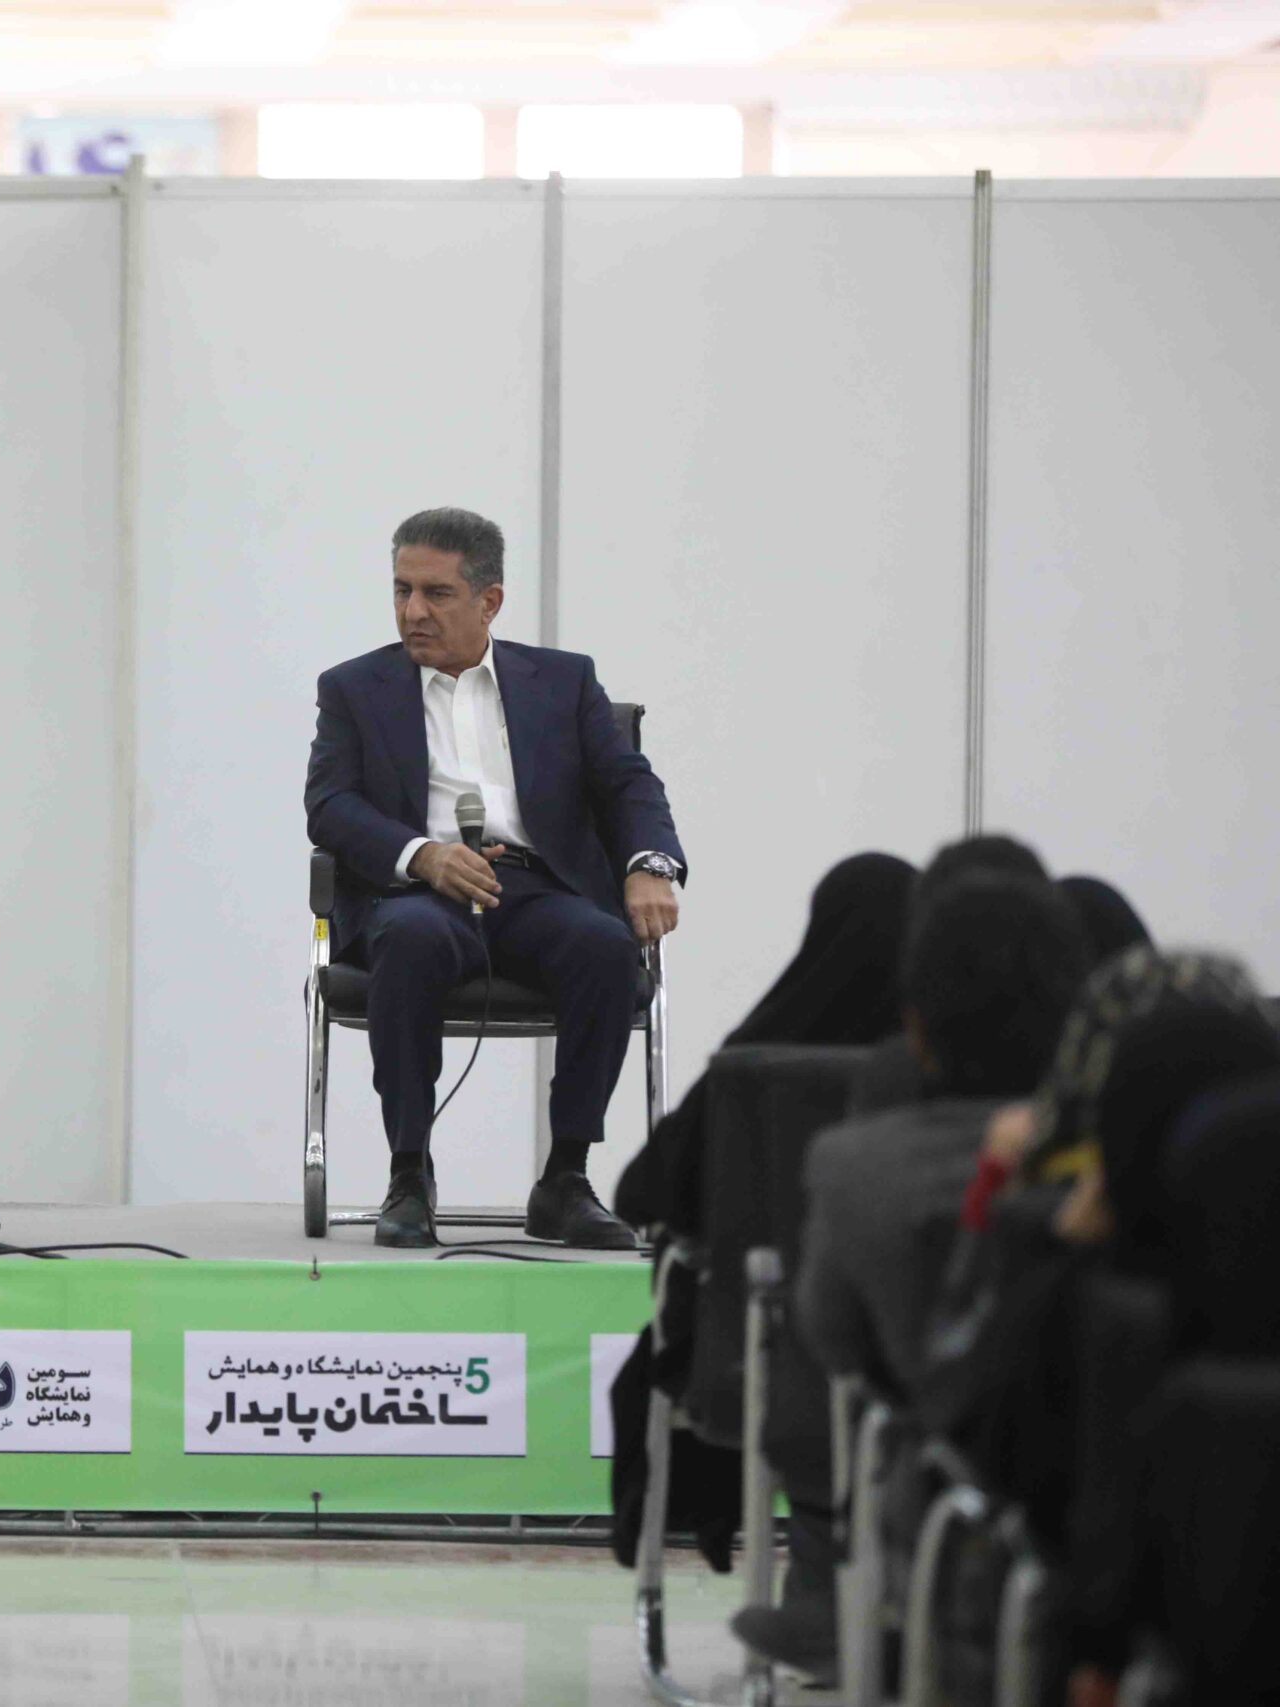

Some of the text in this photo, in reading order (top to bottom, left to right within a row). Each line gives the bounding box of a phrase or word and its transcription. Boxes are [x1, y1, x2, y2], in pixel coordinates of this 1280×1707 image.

[26, 1366, 92, 1384] سومین
[296, 1355, 384, 1380] نمایشگاه
[386, 1362, 463, 1388] پنجمین
[464, 1357, 491, 1395] 5
[25, 1385, 91, 1406] نمایشگاه
[205, 1387, 489, 1444] ساختمان پایدار
